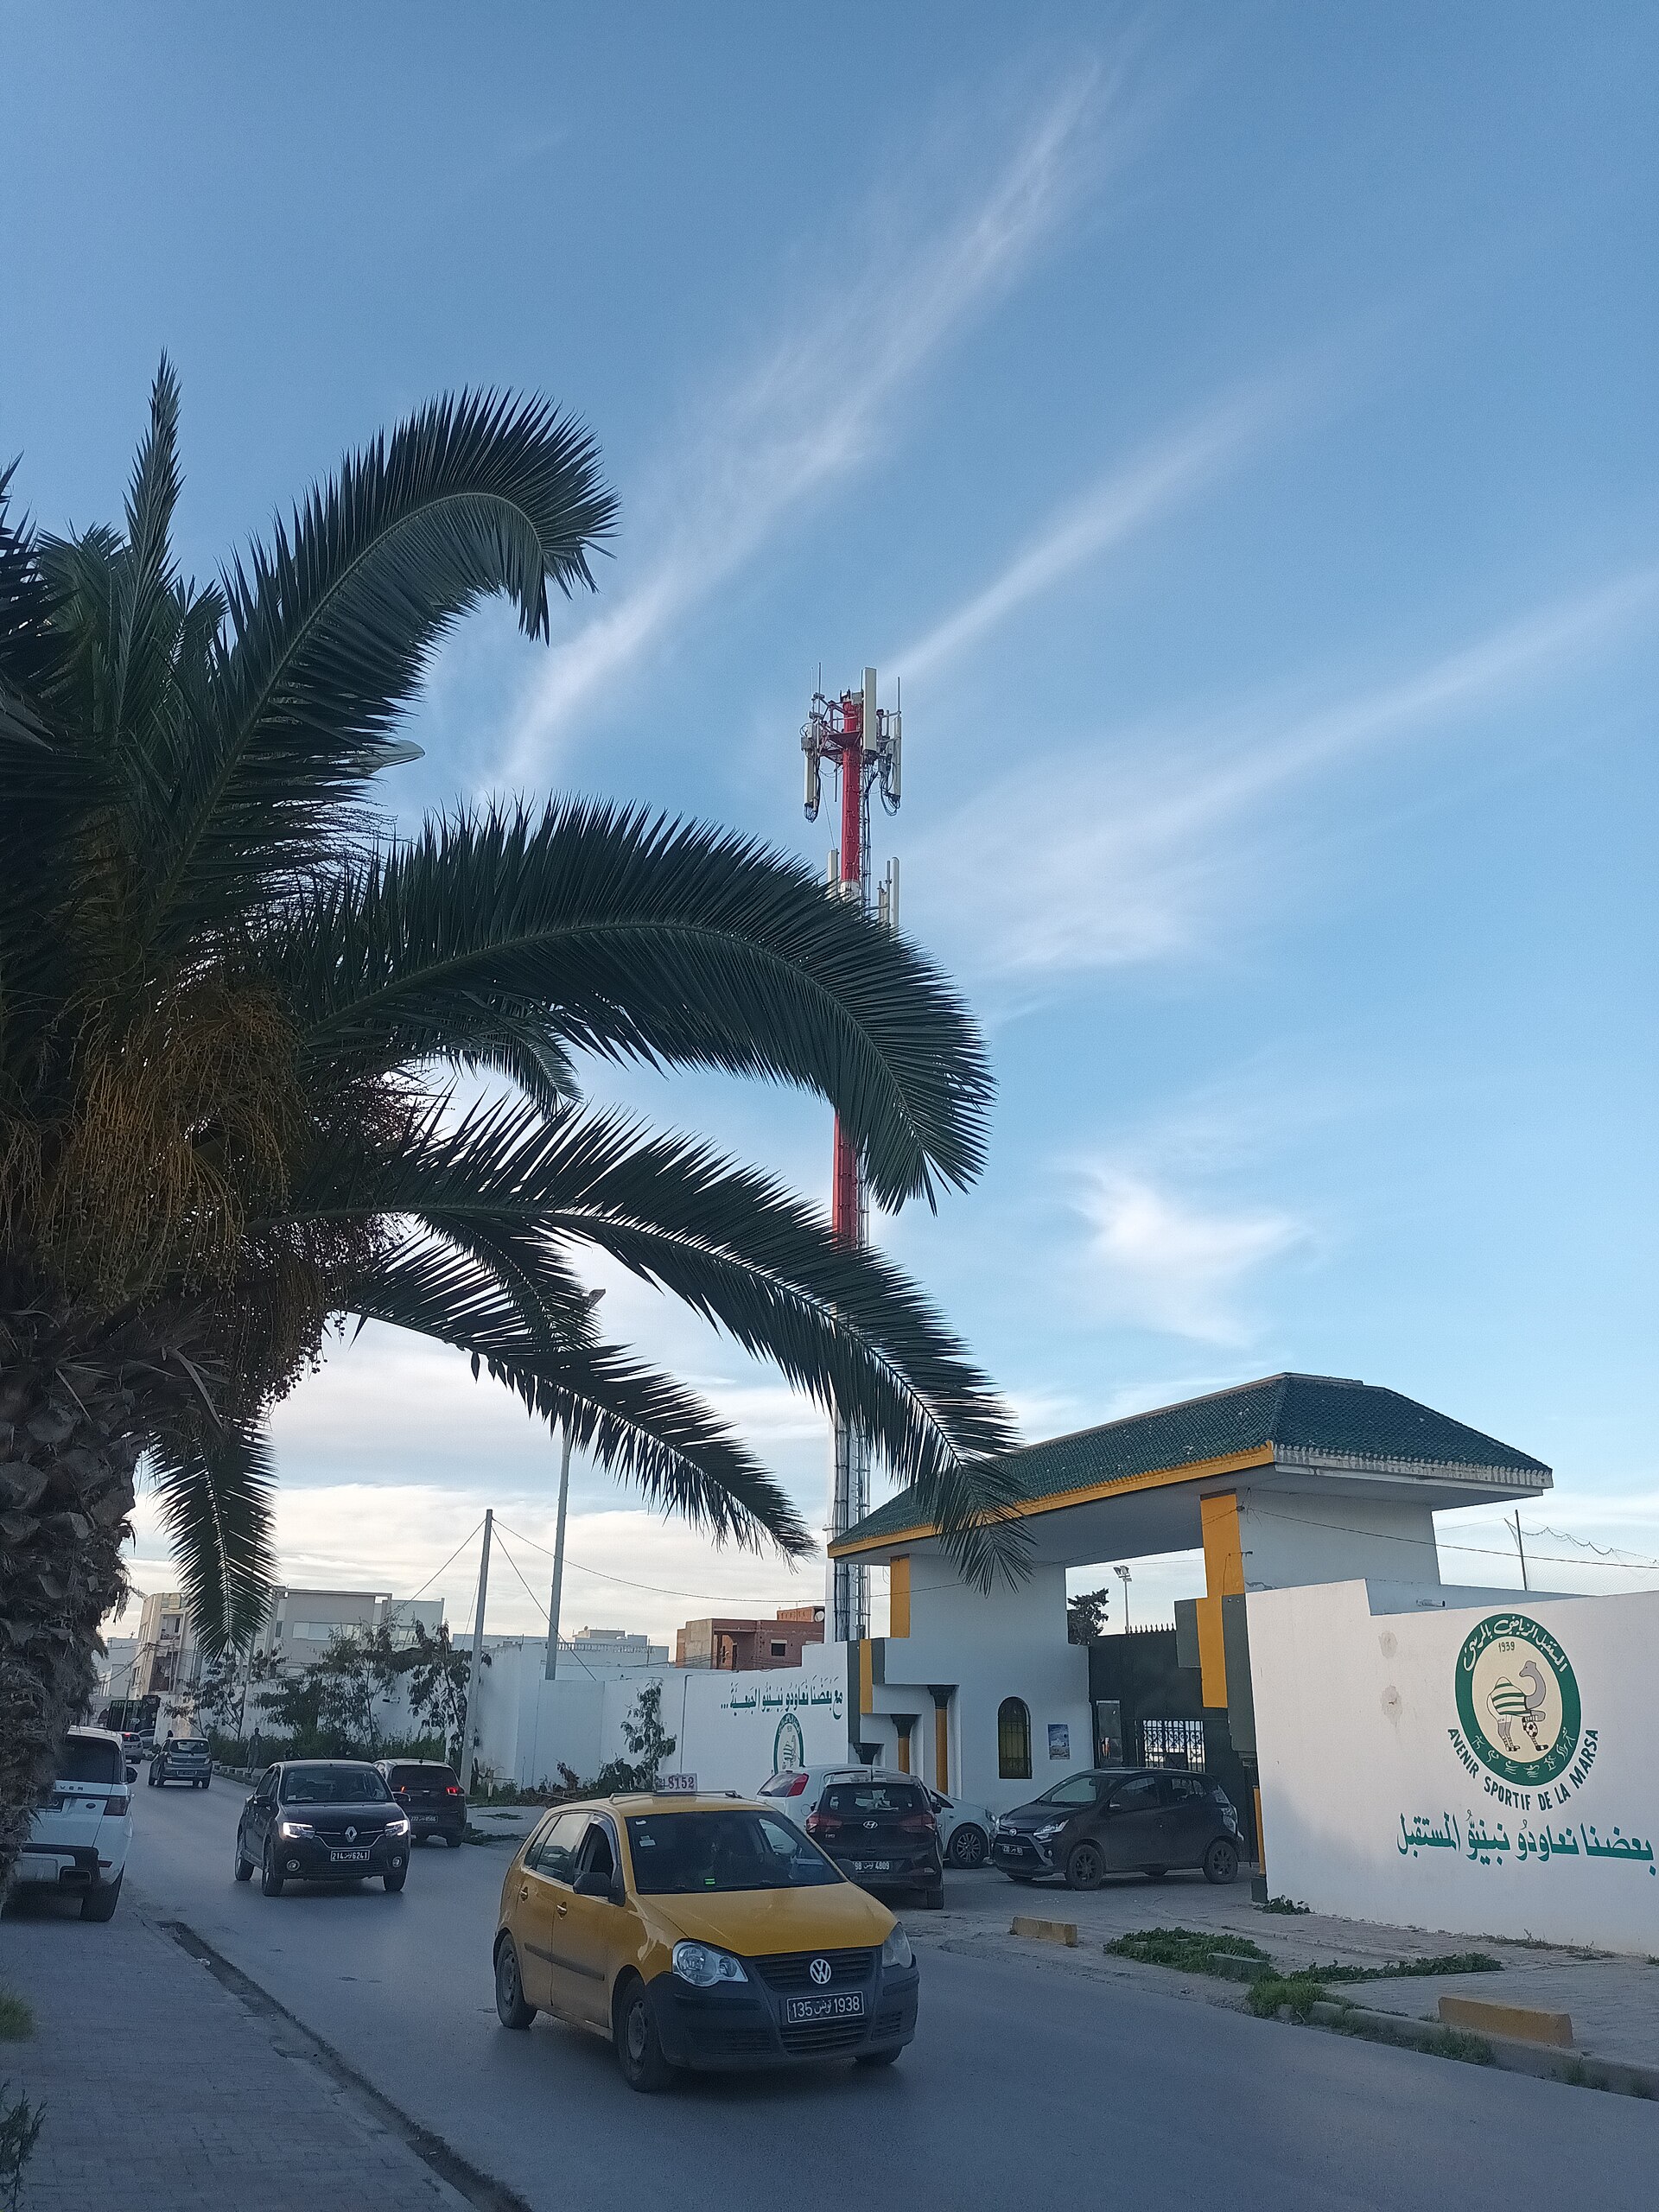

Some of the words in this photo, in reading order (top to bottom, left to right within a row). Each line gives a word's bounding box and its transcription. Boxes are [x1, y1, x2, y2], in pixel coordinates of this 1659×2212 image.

[1497, 1641, 1516, 1653] 1939
[668, 1776, 695, 1789] 8152
[1447, 1728, 1480, 1779] AVENIR
[1484, 1776, 1531, 1811] SPORTIF
[1537, 1790, 1554, 1811] DE
[1554, 1783, 1572, 1805] LA
[1568, 1729, 1599, 1789] MARSA
[1396, 1811, 1461, 1859] المستقبل
[1580, 1821, 1656, 1876] بعضنا
[792, 2001, 813, 2018] 135
[833, 1996, 861, 2013] 1938
